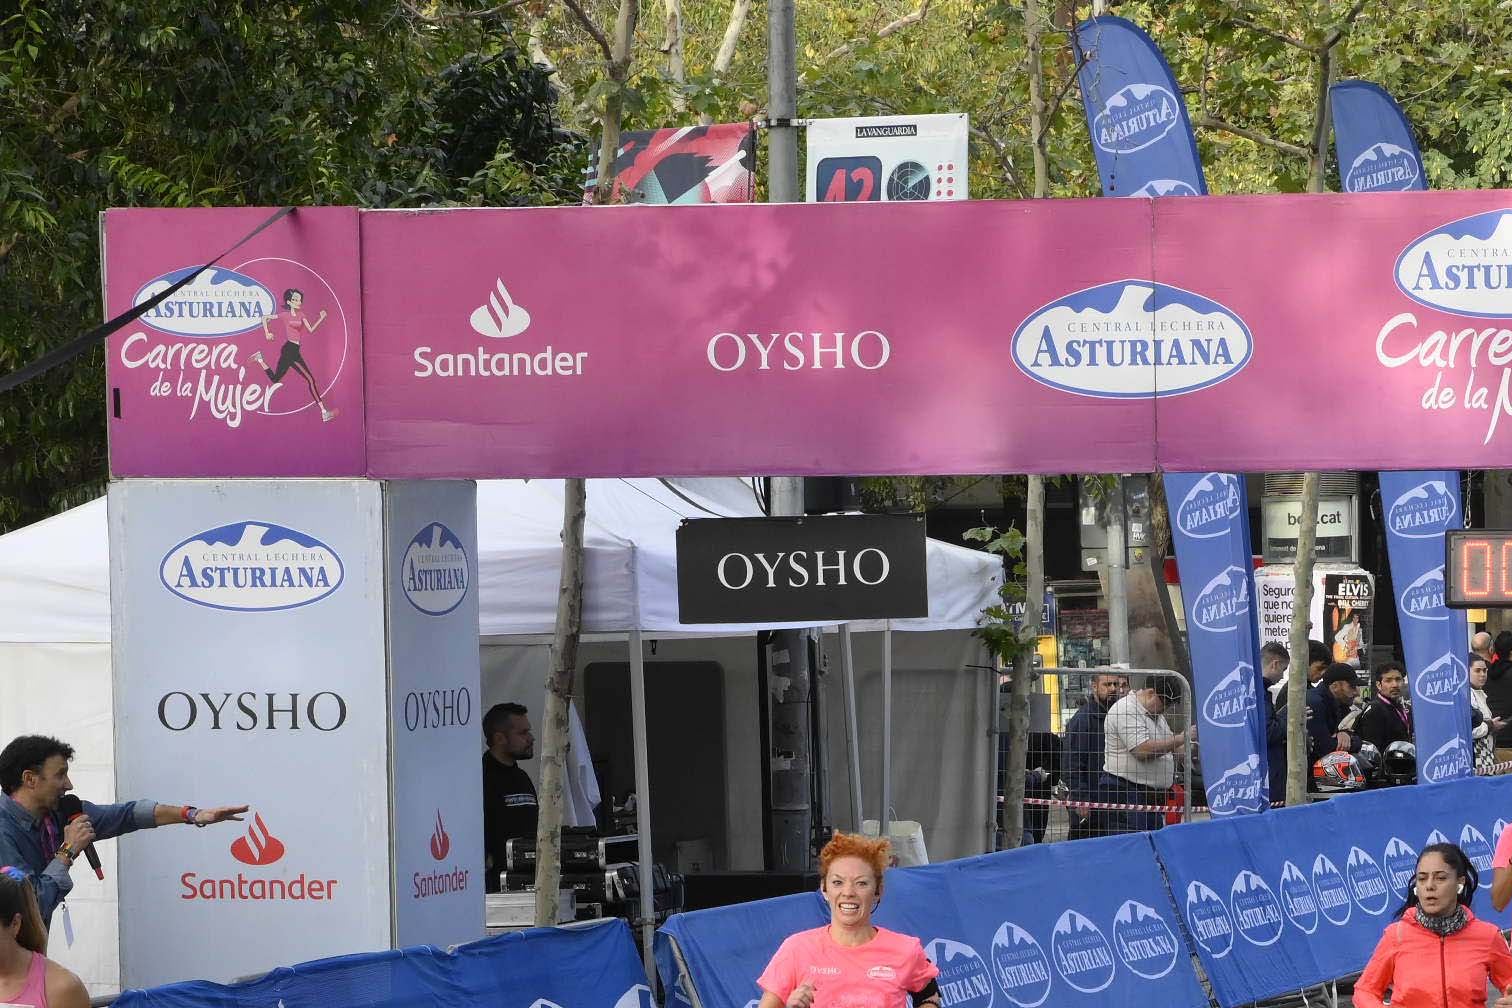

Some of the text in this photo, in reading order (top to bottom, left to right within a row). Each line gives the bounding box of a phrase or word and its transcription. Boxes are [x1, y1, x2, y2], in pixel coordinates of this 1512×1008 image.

[171, 289, 261, 298] ENTRAL LECHERA
[1067, 319, 1226, 334] CENTRAL LECHERA
[120, 331, 239, 370] Carrera
[413, 345, 589, 378] Santander
[706, 330, 891, 372] OYSHO
[1029, 324, 1235, 368] ASTURIANA
[149, 365, 285, 429] de la Mujer
[1421, 370, 1457, 410] de
[1463, 366, 1489, 410] la
[174, 554, 331, 589] ASTURIANA
[202, 552, 325, 562] CENTRAL LECHERA
[406, 555, 466, 592] ASTURIANA
[717, 547, 890, 591] OYSHO
[1338, 583, 1369, 596] ELVIS
[157, 691, 348, 732] OYSHO
[404, 687, 472, 732] OYSHO
[180, 872, 339, 902] Santander
[413, 867, 470, 900] Santander
[996, 958, 1049, 990] ASTURIANA
[1058, 943, 1113, 976] ASTURIANA
